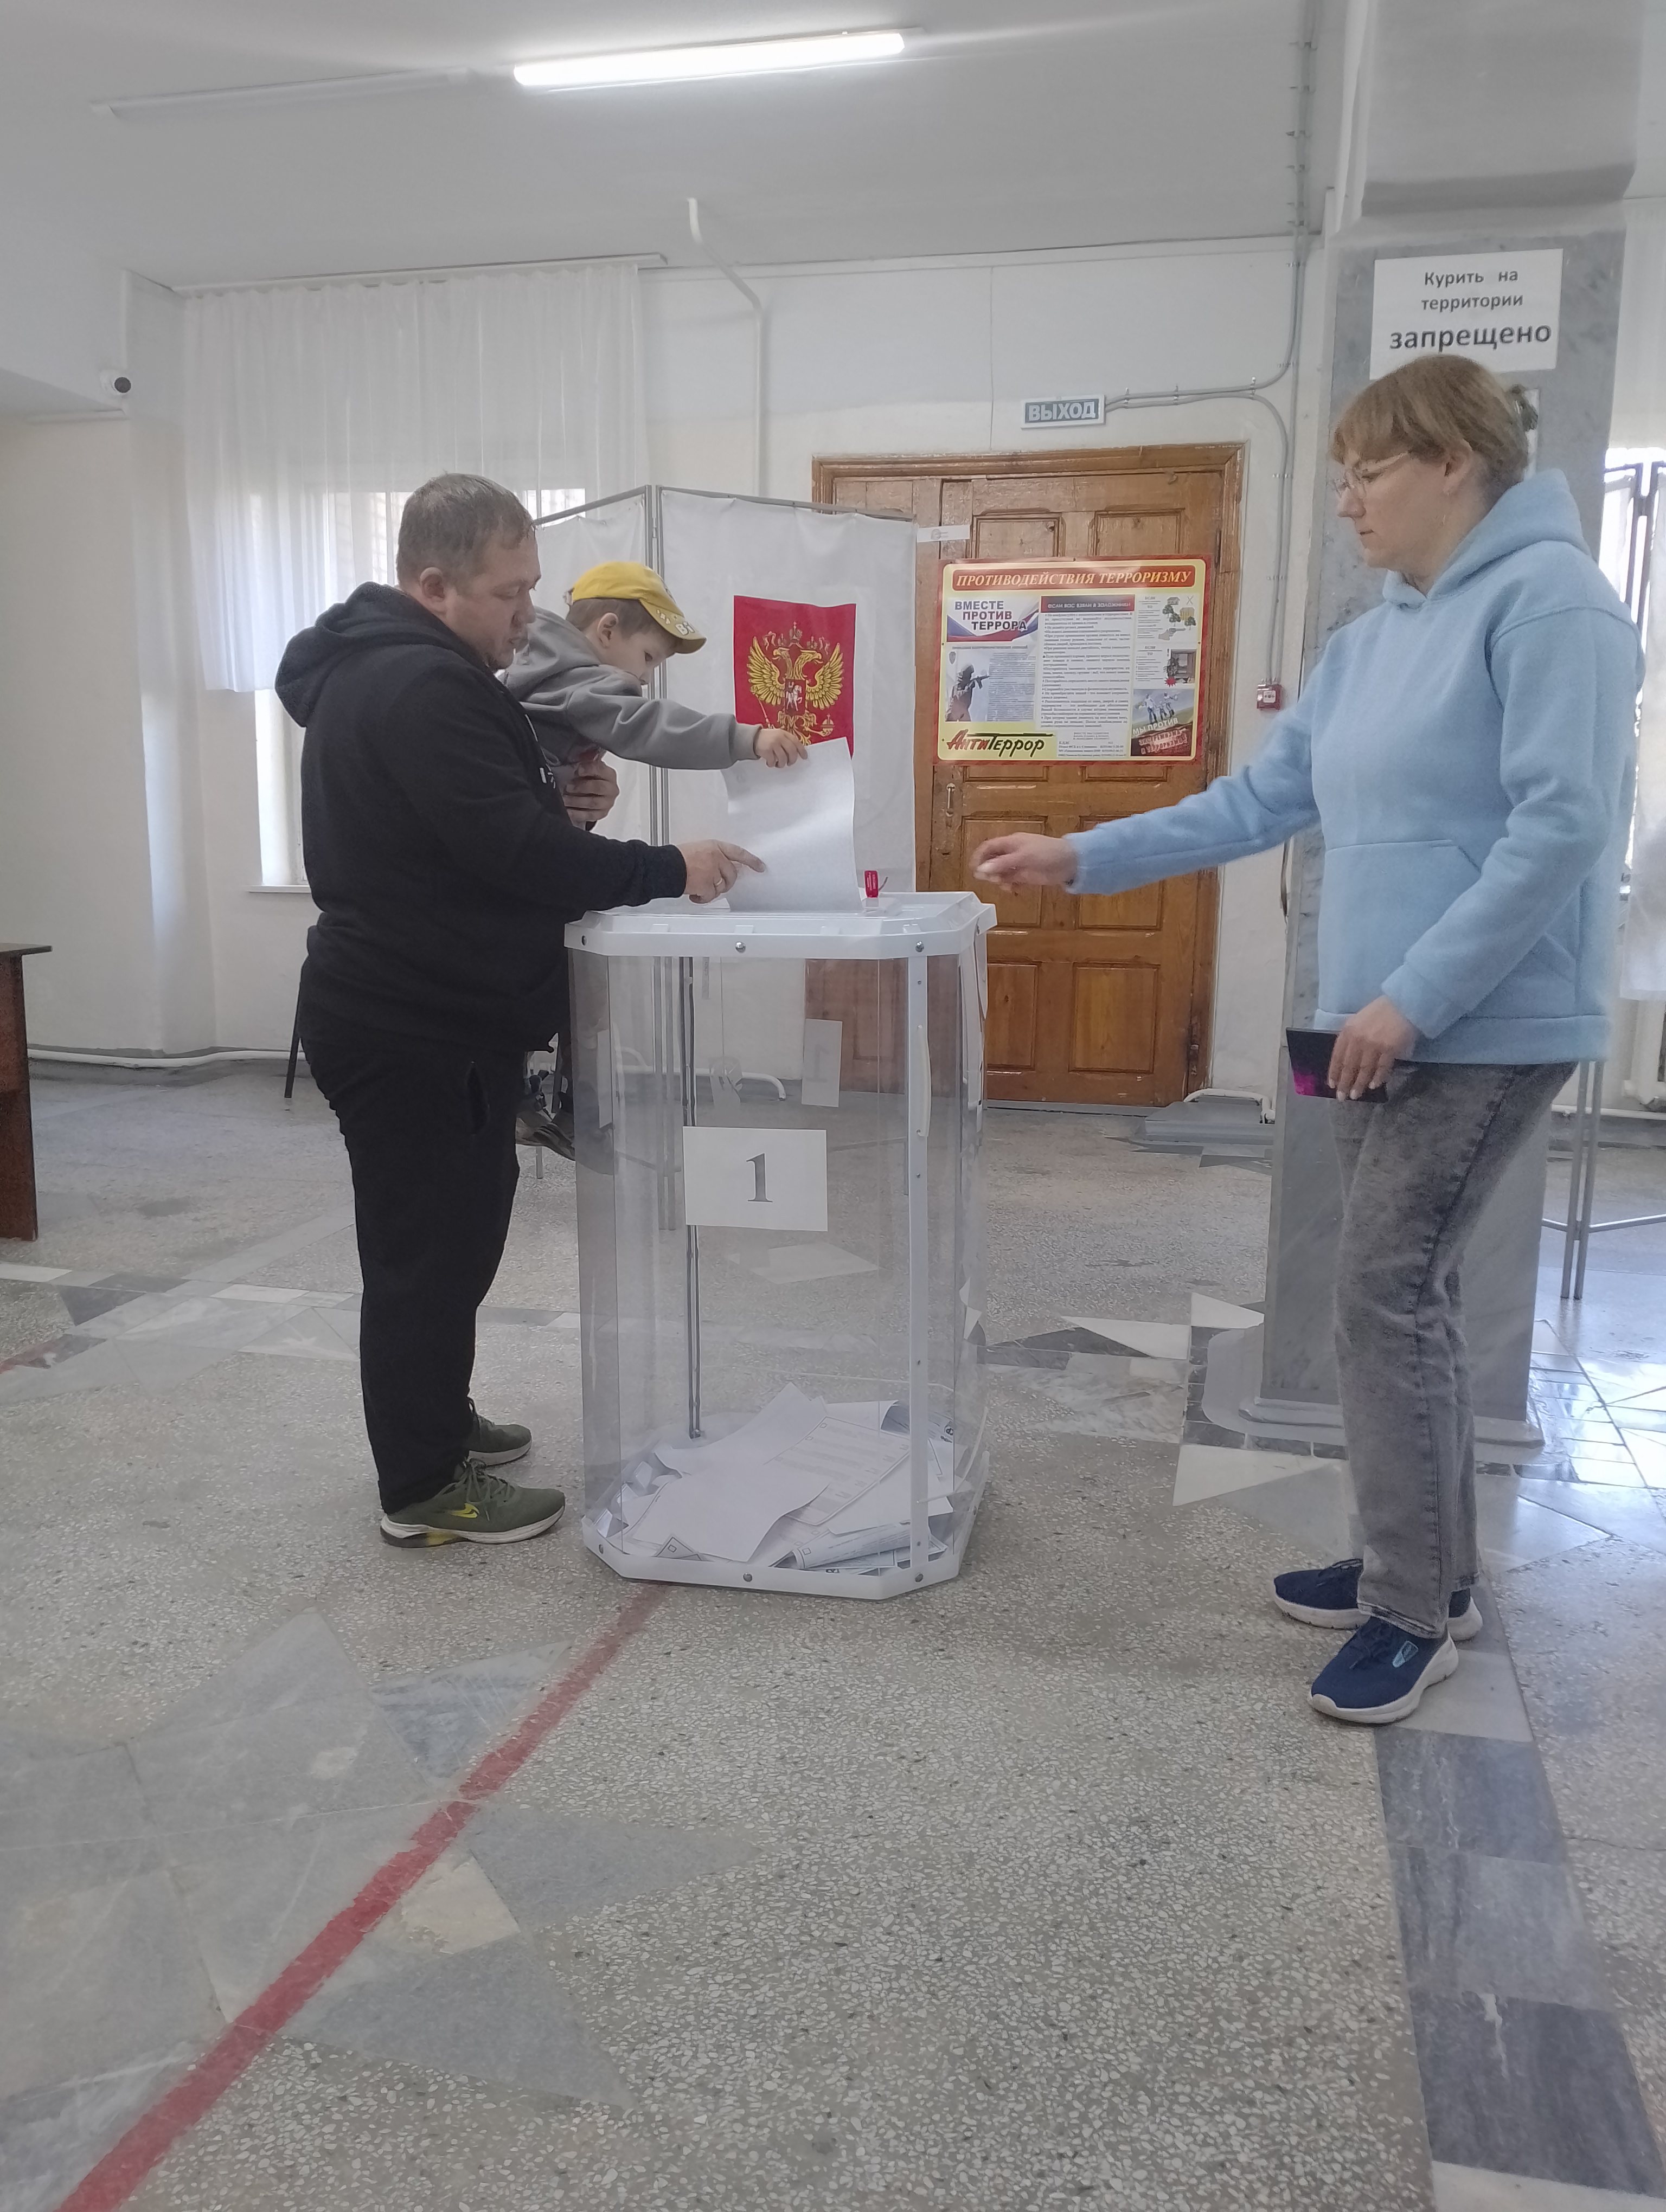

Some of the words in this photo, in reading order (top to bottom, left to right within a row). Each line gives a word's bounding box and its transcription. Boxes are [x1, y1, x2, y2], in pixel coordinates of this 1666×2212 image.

[1424, 272, 1484, 288] Курить
[1498, 271, 1518, 282] на
[1421, 295, 1523, 313] территории
[1389, 325, 1552, 353] запрещено
[1028, 401, 1096, 421] ВЫХОД
[956, 571, 1095, 587] ПРОТИВОДЕЙСТВИЯ
[1099, 571, 1193, 584] ТЕРРОРИЗМУ
[954, 600, 1004, 610] ВМЕСТЕ
[963, 610, 1013, 620] ПРОТИВ
[971, 620, 1027, 631] ТЕРРОРА
[1132, 726, 1146, 735] МЫ
[1148, 717, 1178, 731] ПРОТИВ
[746, 1153, 773, 1203] 1
